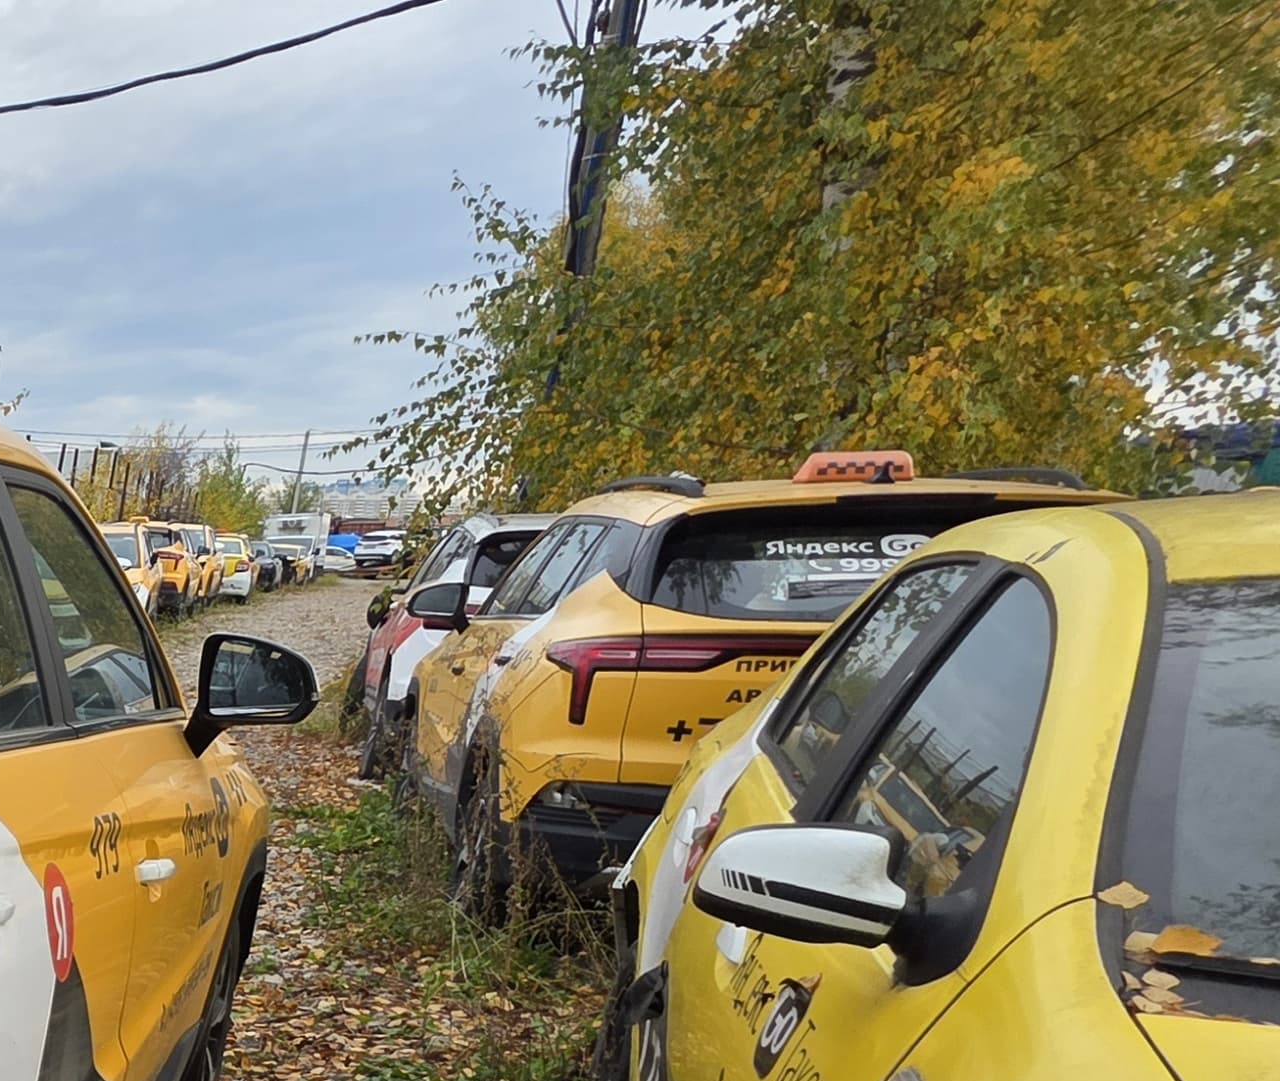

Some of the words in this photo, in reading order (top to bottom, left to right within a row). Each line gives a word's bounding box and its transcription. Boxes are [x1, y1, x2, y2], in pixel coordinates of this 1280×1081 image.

[765, 540, 874, 555] Яндекс
[839, 558, 900, 572] 999
[726, 689, 762, 703] АР
[90, 811, 122, 880] 979
[51, 885, 68, 961] Я
